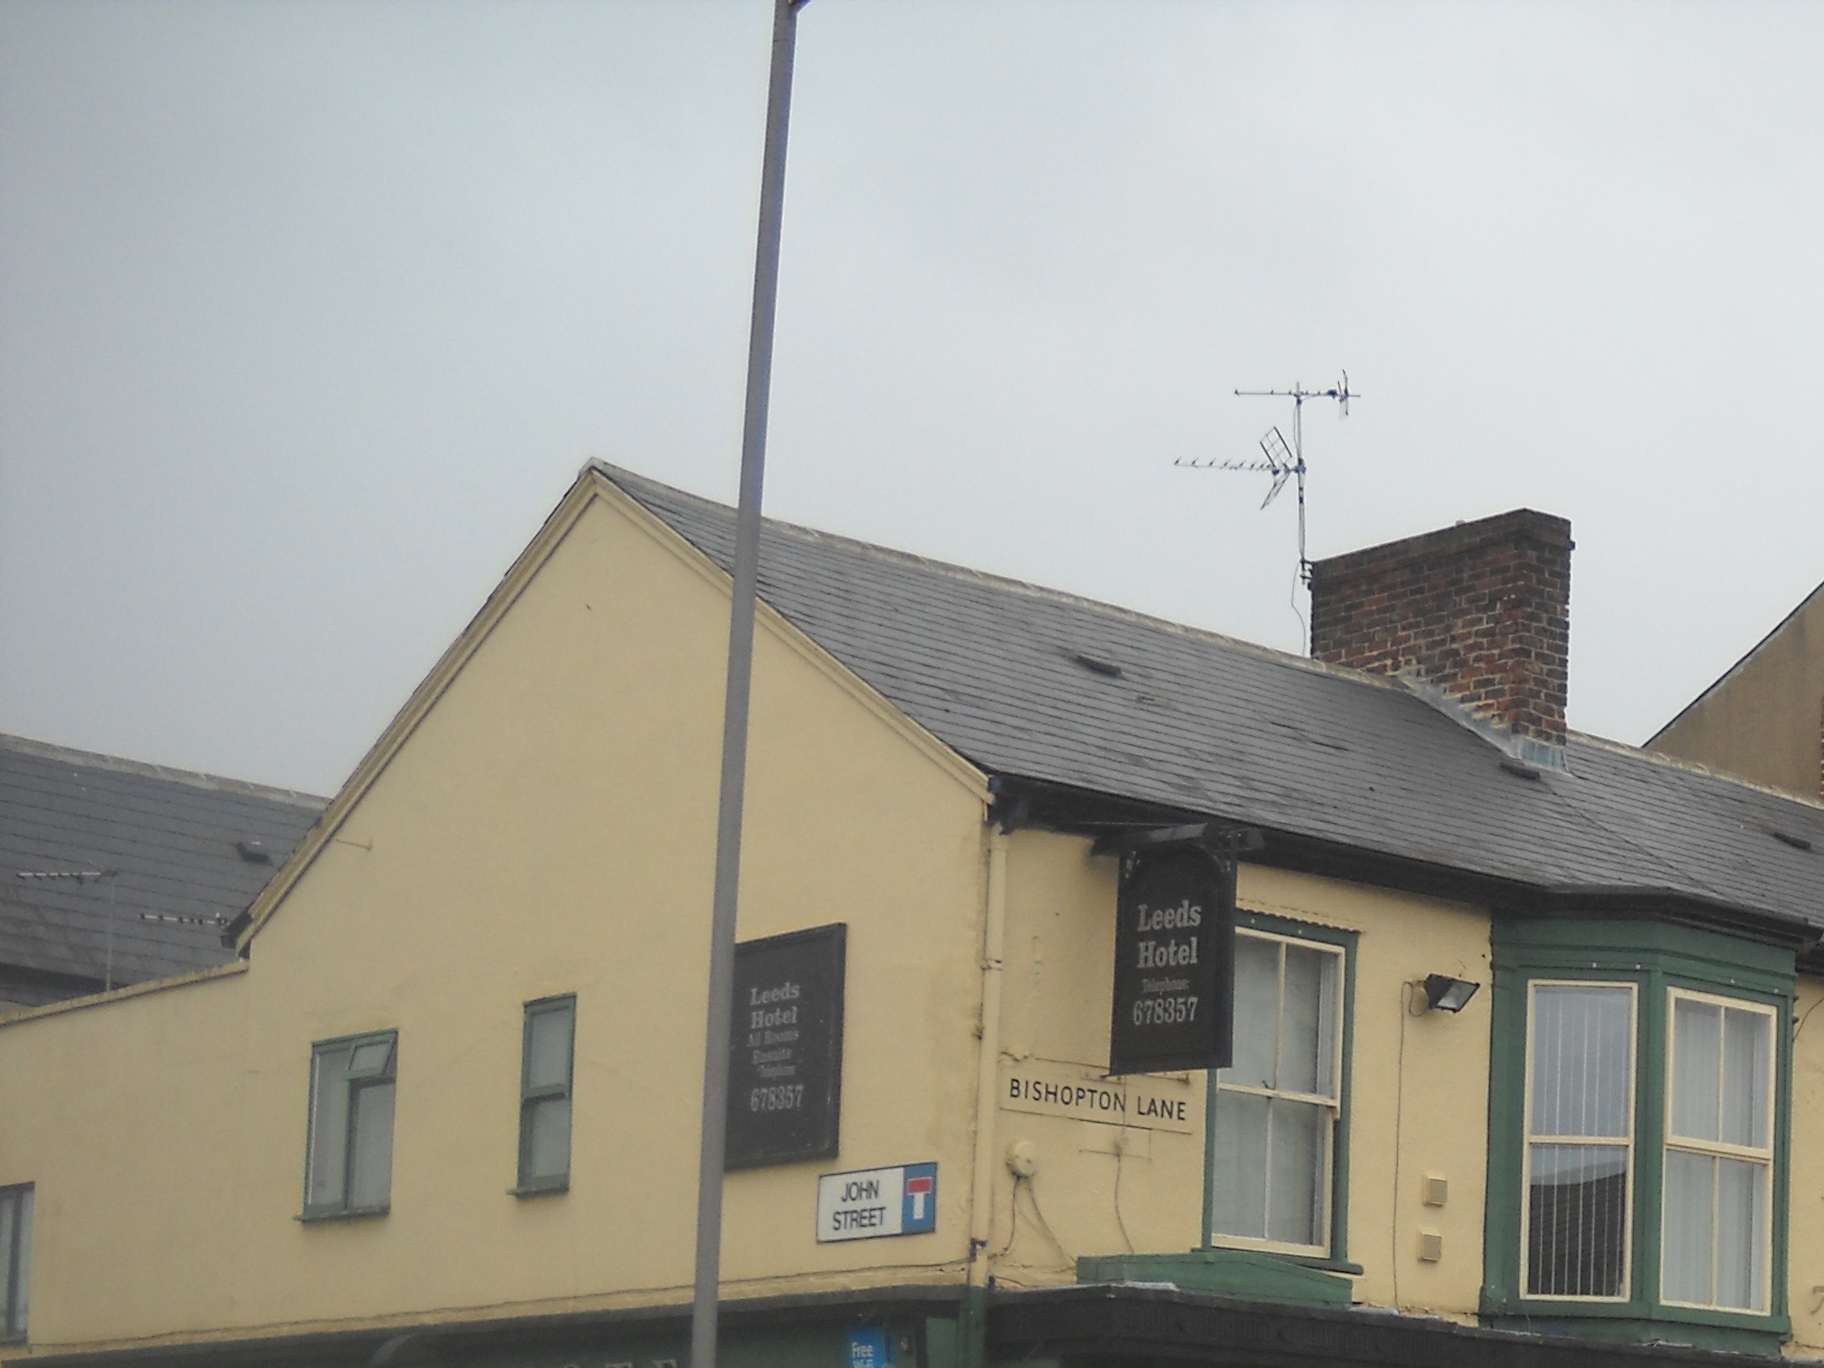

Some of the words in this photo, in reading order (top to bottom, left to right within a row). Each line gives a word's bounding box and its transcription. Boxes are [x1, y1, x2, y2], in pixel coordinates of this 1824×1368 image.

[1137, 900, 1201, 931] Leeds
[1137, 937, 1198, 968] Hotel
[750, 981, 799, 1006] Leeds
[751, 1006, 797, 1029] Hotel
[1133, 996, 1198, 1026] 678357
[751, 1084, 804, 1112] 678357
[1010, 1078, 1126, 1112] BISHOPTON
[1137, 1096, 1186, 1121] LANE
[841, 1180, 879, 1202] JOHN
[833, 1207, 886, 1231] STREET
